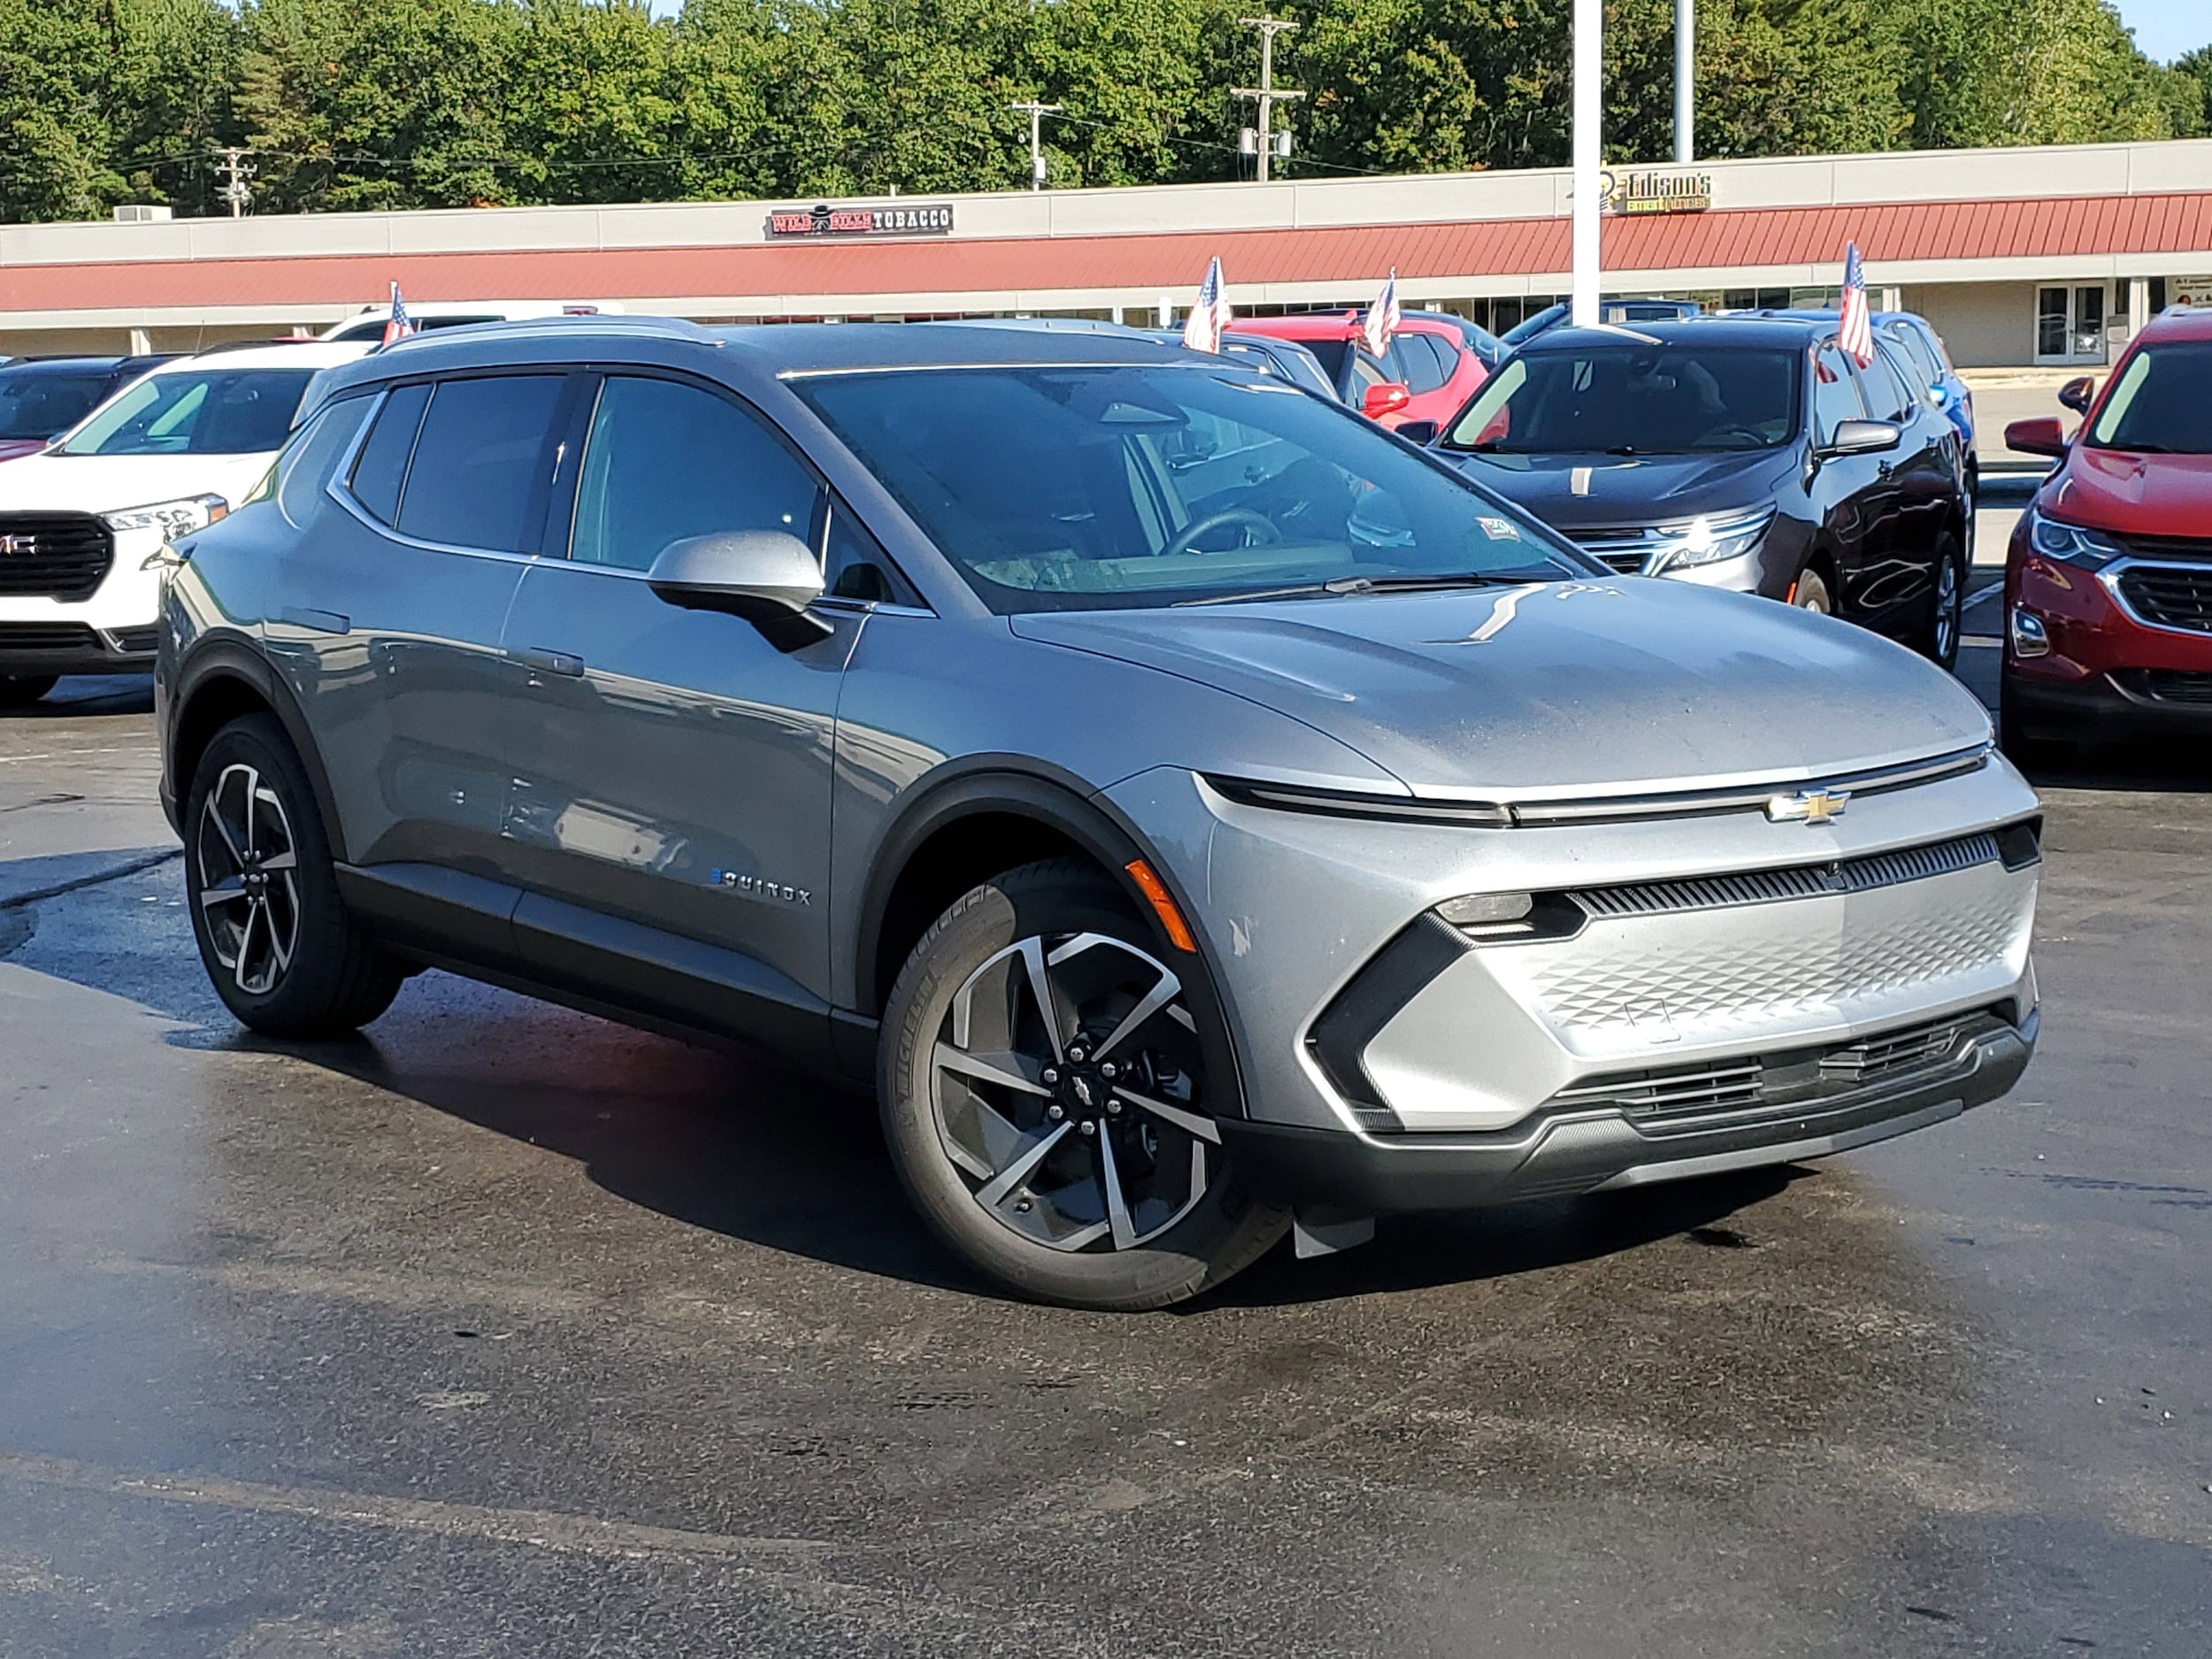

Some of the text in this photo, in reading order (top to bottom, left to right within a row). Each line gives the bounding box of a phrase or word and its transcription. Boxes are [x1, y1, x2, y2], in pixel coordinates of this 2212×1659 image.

[1628, 172, 1711, 197] Edison's
[772, 213, 811, 232] WILD
[873, 209, 949, 228] TOBACCO
[710, 867, 812, 906] EQUINOX
[895, 972, 936, 1099] MICHELIN
